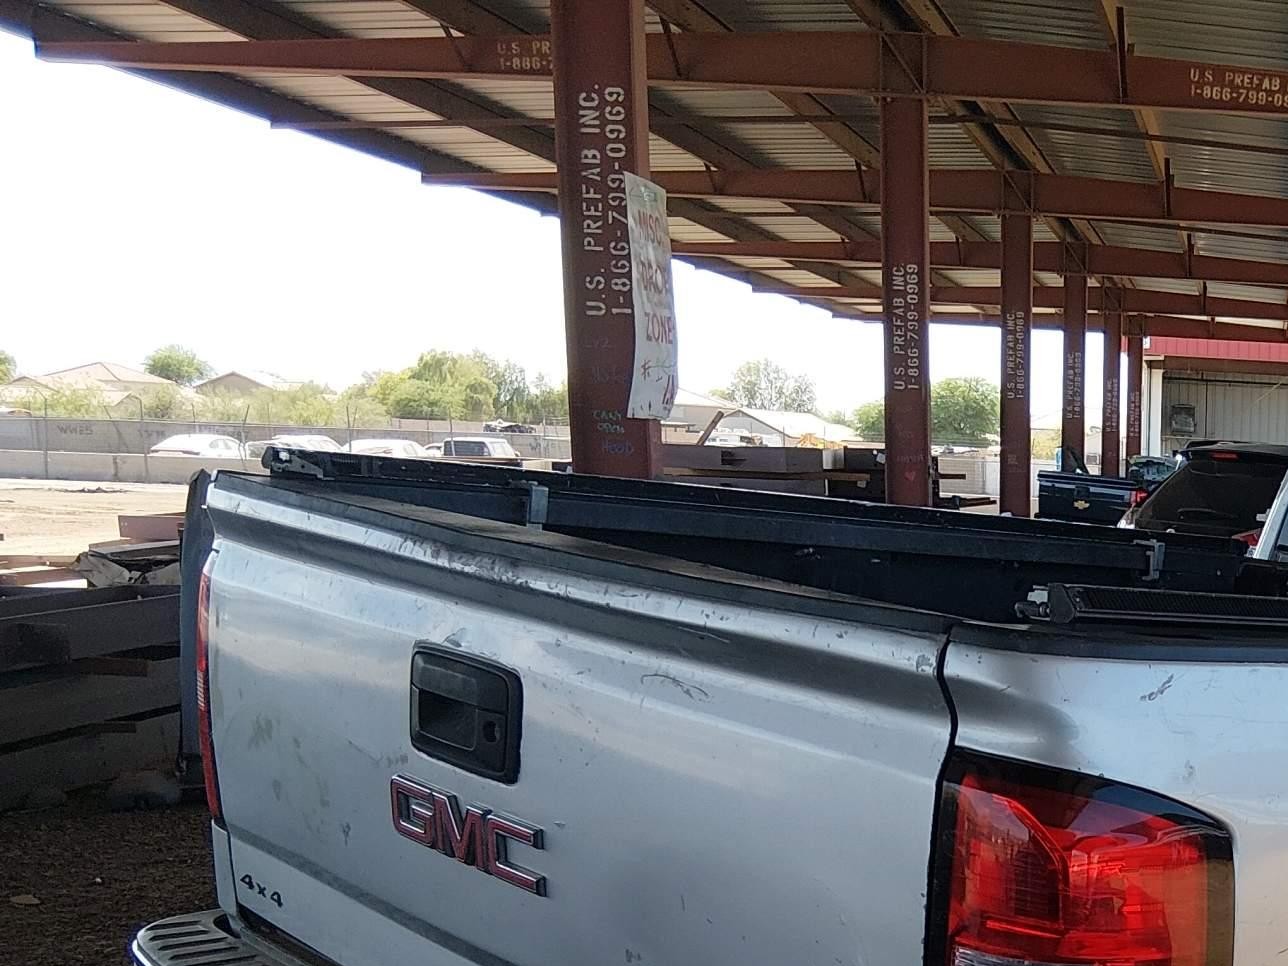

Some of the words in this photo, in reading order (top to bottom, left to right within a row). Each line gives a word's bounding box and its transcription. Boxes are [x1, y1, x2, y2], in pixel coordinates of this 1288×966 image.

[578, 83, 601, 133] INC.
[1225, 71, 1281, 91] PREFAB
[581, 148, 604, 251] PREFAB
[604, 86, 632, 315] 1-866-799-0969
[585, 267, 607, 316] U.S.
[892, 262, 905, 291] INC.
[893, 297, 906, 355] PREFAB
[906, 263, 919, 390] 1-866-799-0969
[390, 773, 548, 898] GMC
[239, 872, 285, 908] 4x4
